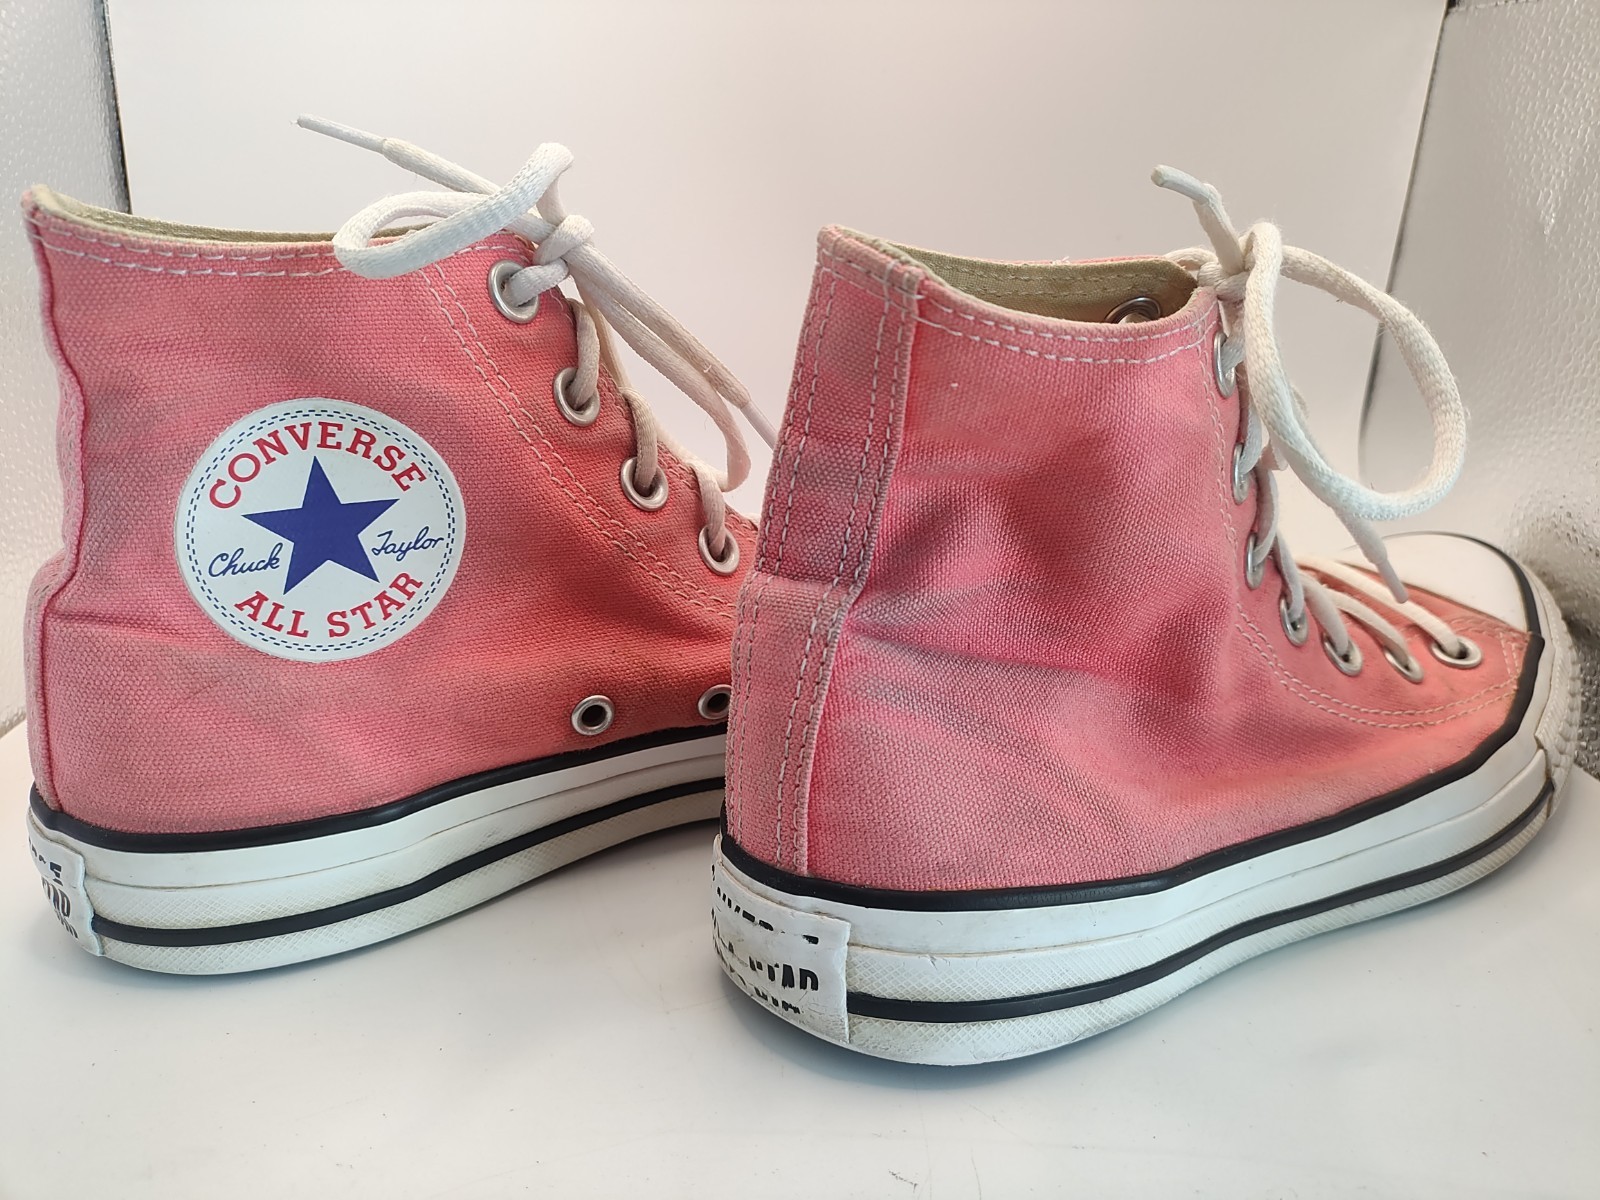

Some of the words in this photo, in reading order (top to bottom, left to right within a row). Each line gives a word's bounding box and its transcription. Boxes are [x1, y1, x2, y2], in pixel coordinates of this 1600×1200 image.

[209, 421, 427, 509] CONVERSE
[208, 543, 284, 577] Chuck
[372, 526, 444, 561] Taylor
[234, 590, 309, 638] ALL
[326, 572, 424, 638] STAR
